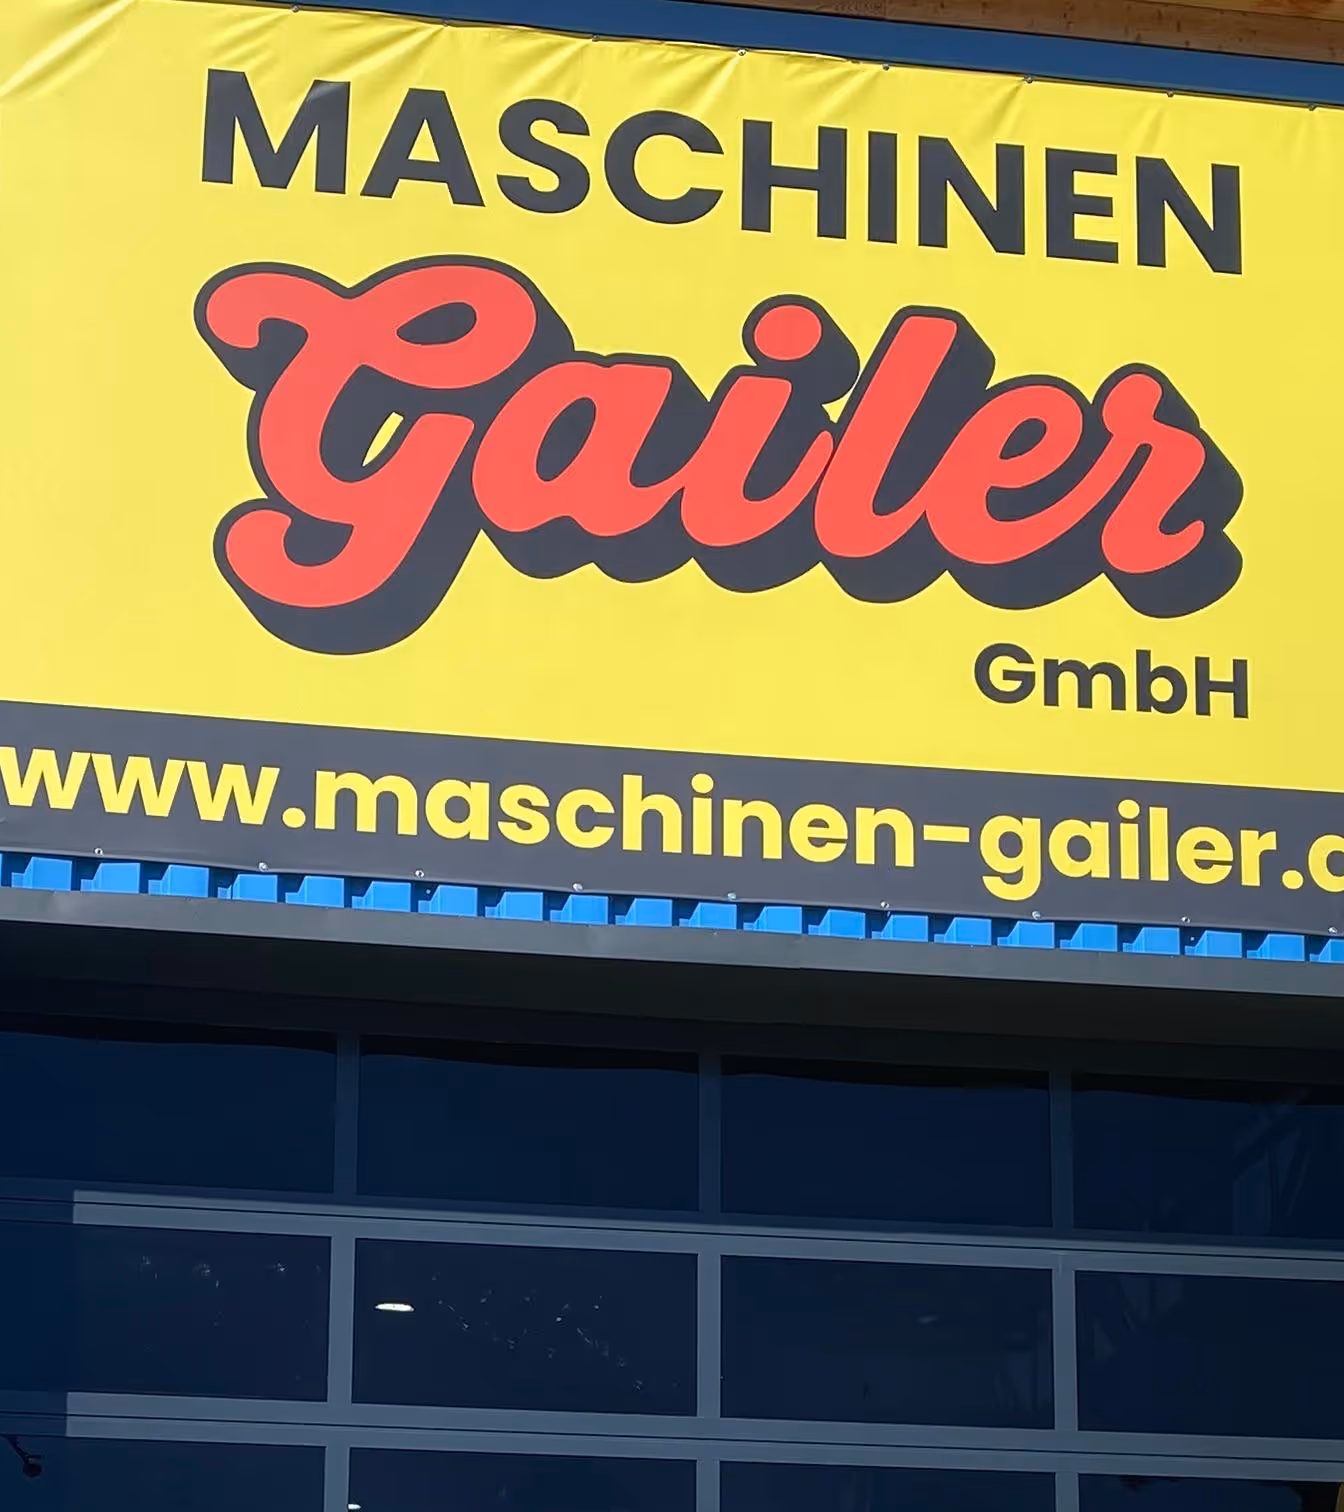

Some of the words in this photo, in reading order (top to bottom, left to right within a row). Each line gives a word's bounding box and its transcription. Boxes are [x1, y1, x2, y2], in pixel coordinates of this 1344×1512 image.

[202, 69, 1242, 275] MASCHINEN
[193, 254, 1246, 656] Gailer
[975, 643, 1249, 719] GmbH
